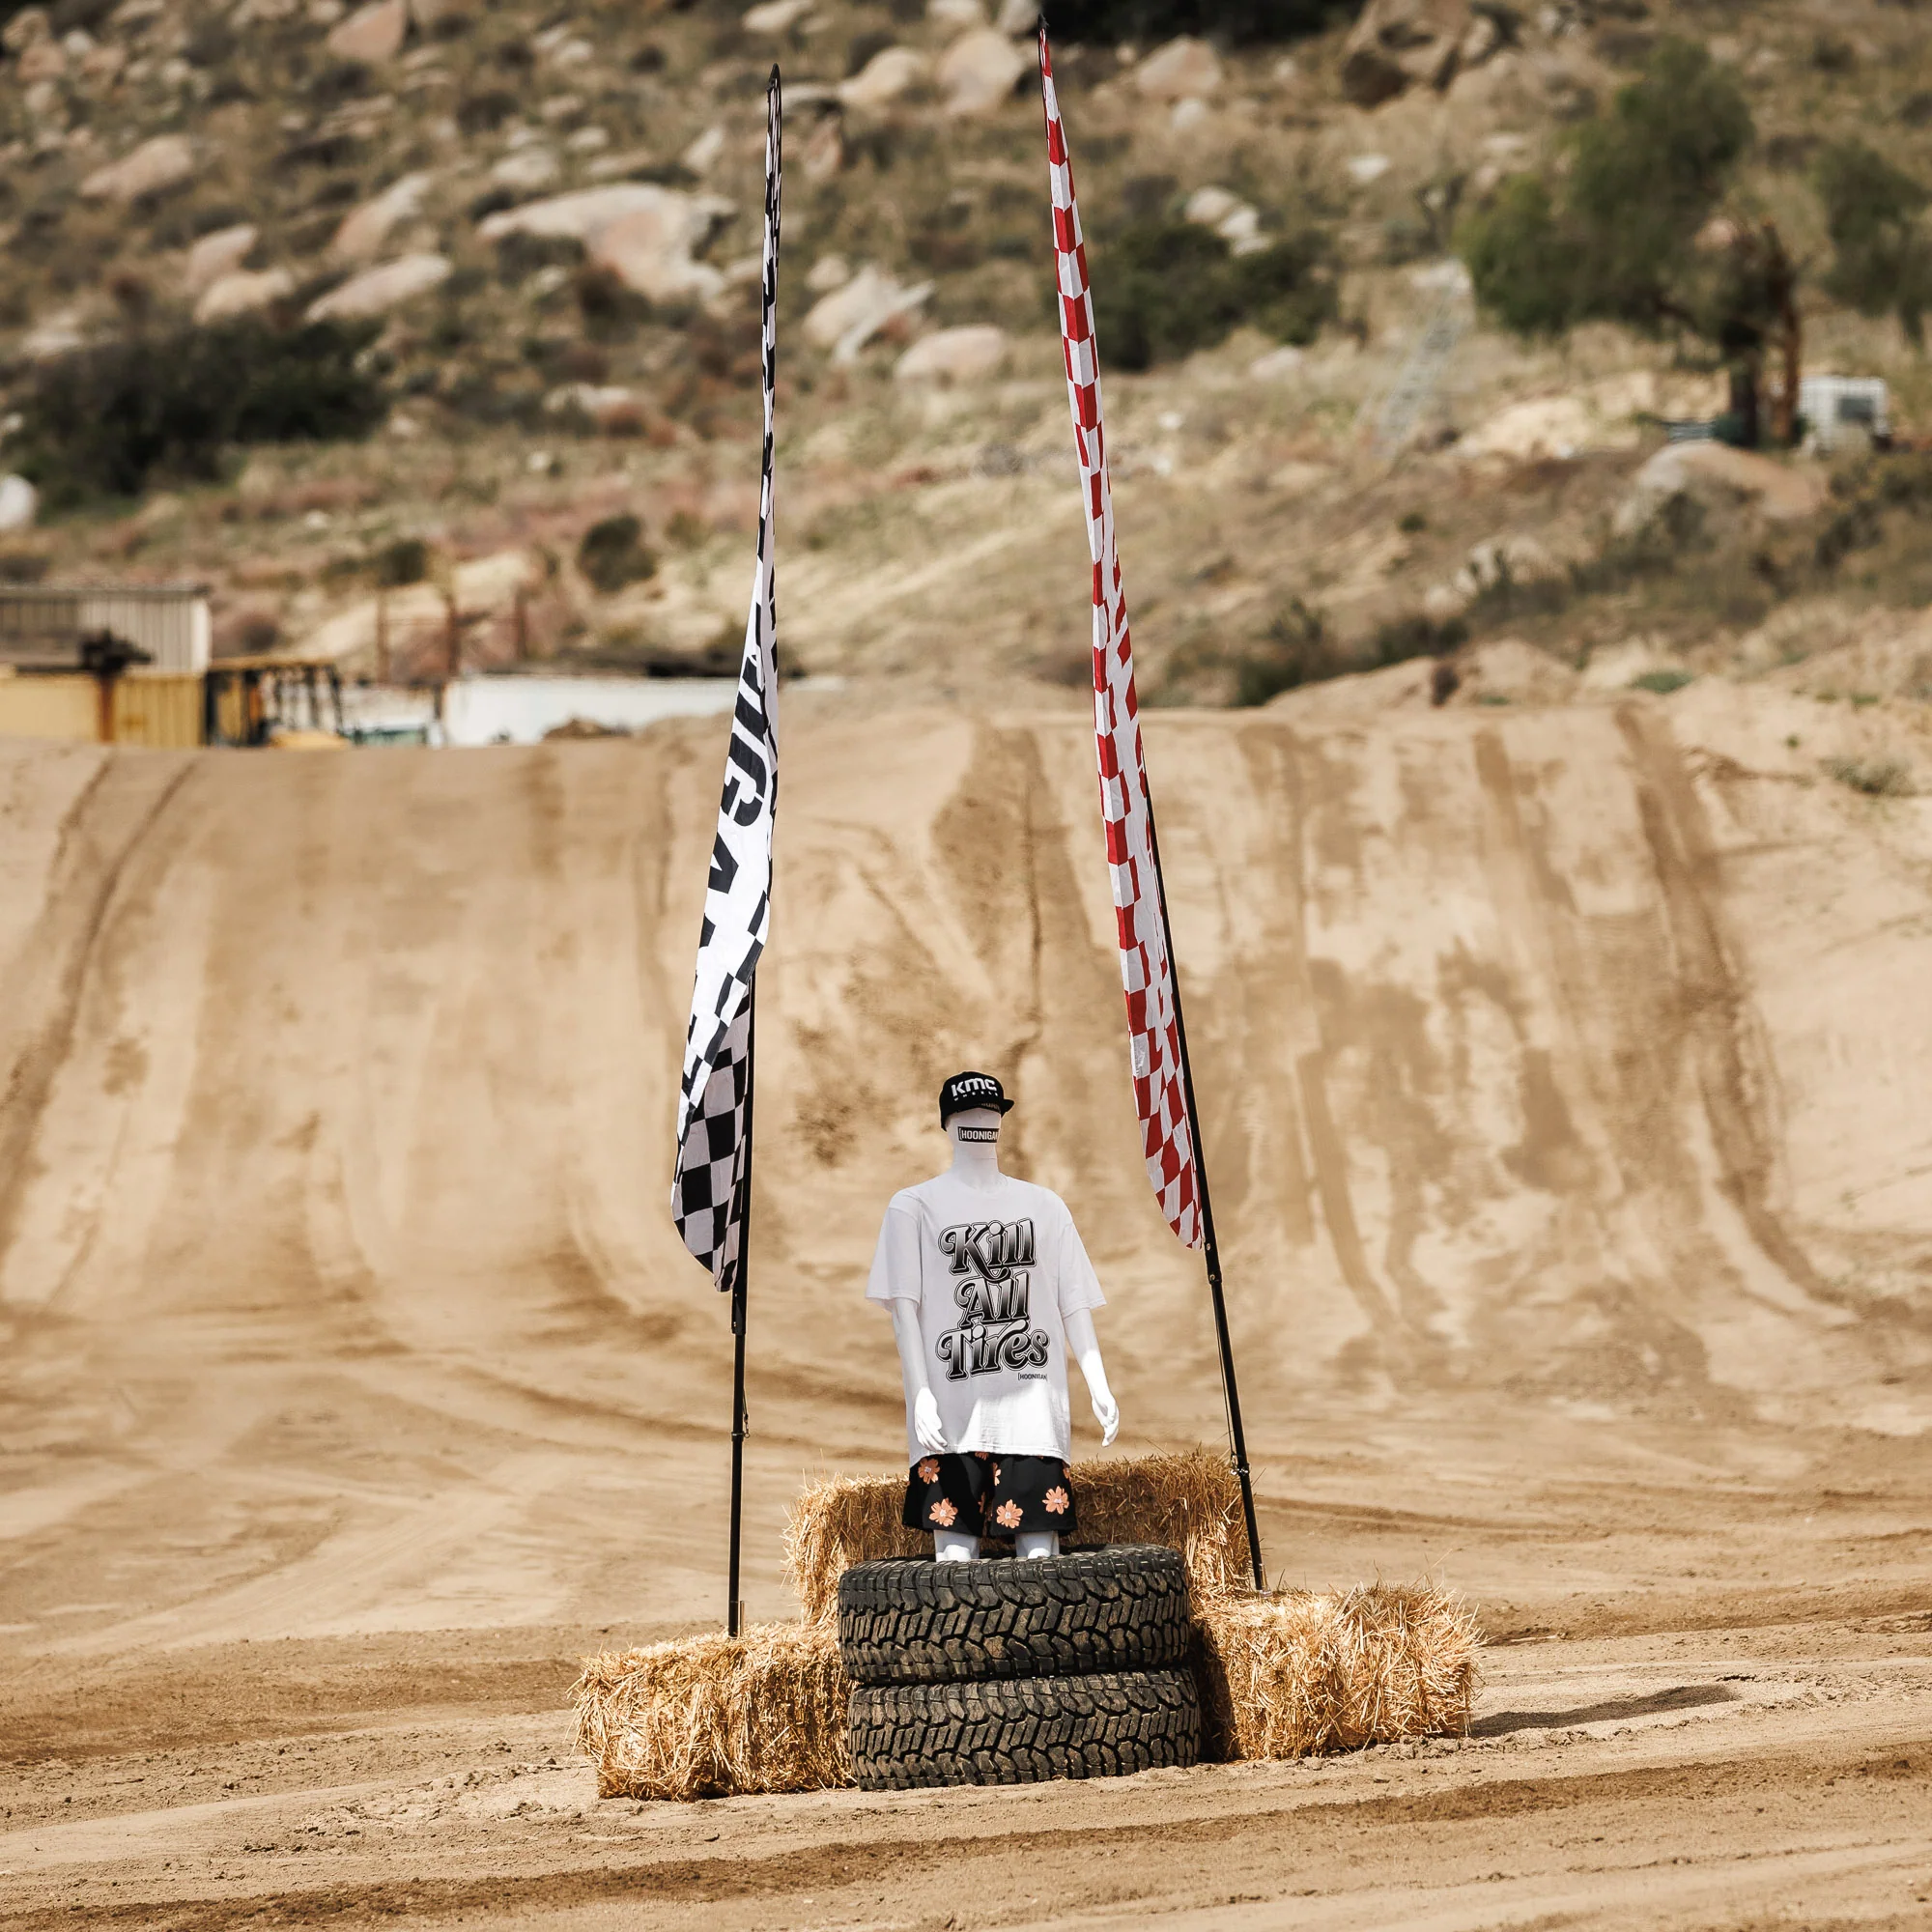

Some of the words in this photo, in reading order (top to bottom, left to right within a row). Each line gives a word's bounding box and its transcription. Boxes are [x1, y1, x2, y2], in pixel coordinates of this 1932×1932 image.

[951, 1077, 998, 1097] KMC
[938, 1217, 1037, 1283] Kill
[953, 1269, 1031, 1329] All
[935, 1319, 1051, 1382] Tires
